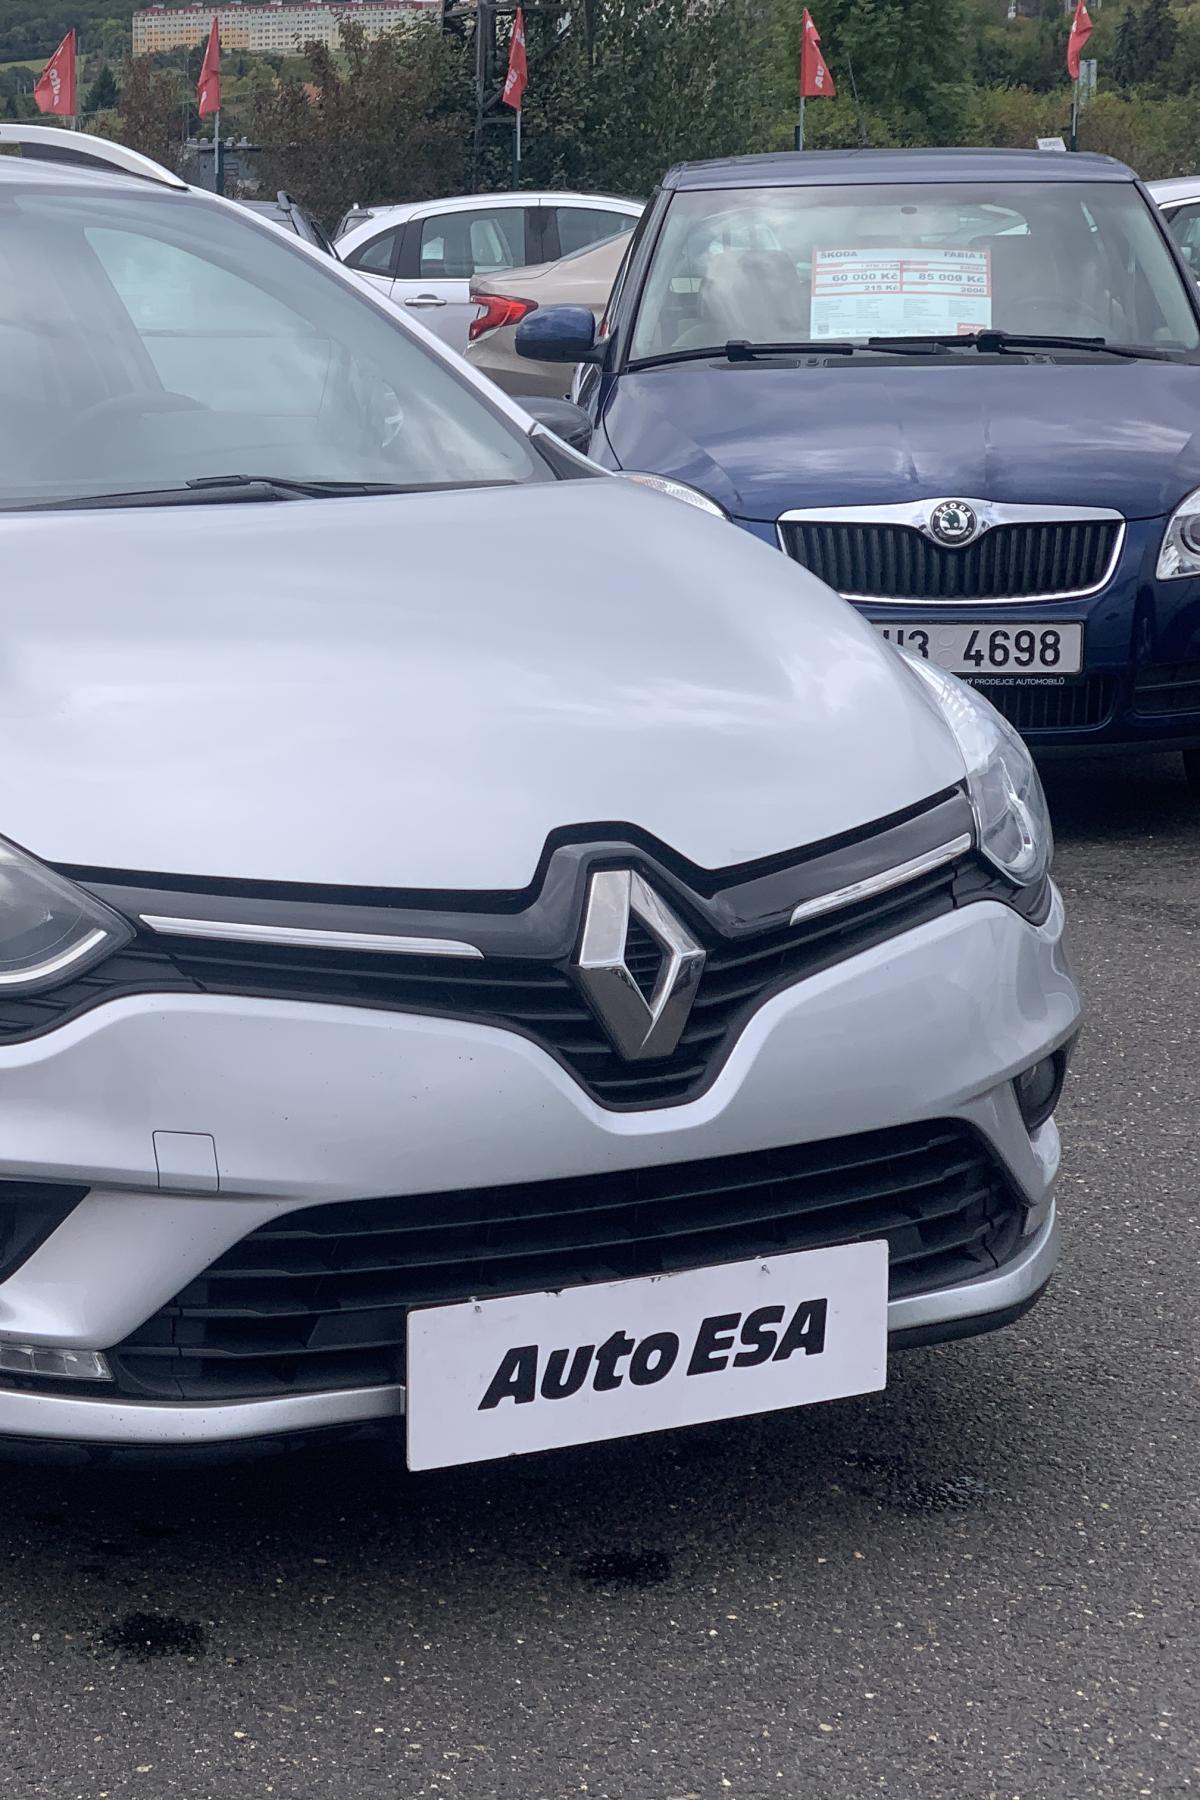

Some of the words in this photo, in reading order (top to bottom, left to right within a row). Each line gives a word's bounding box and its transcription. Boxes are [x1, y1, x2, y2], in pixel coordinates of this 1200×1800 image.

[944, 251, 976, 259] FABIA
[832, 274, 848, 282] 60
[852, 273, 876, 281] 000
[881, 272, 898, 280] Kč
[918, 272, 935, 281] 85
[963, 629, 1061, 667] 4698
[974, 678, 1014, 686] PRODEJCE
[1016, 677, 1065, 686] AUTOMOBILŮ
[477, 1330, 680, 1411] Auto
[686, 1298, 828, 1377] ESA
